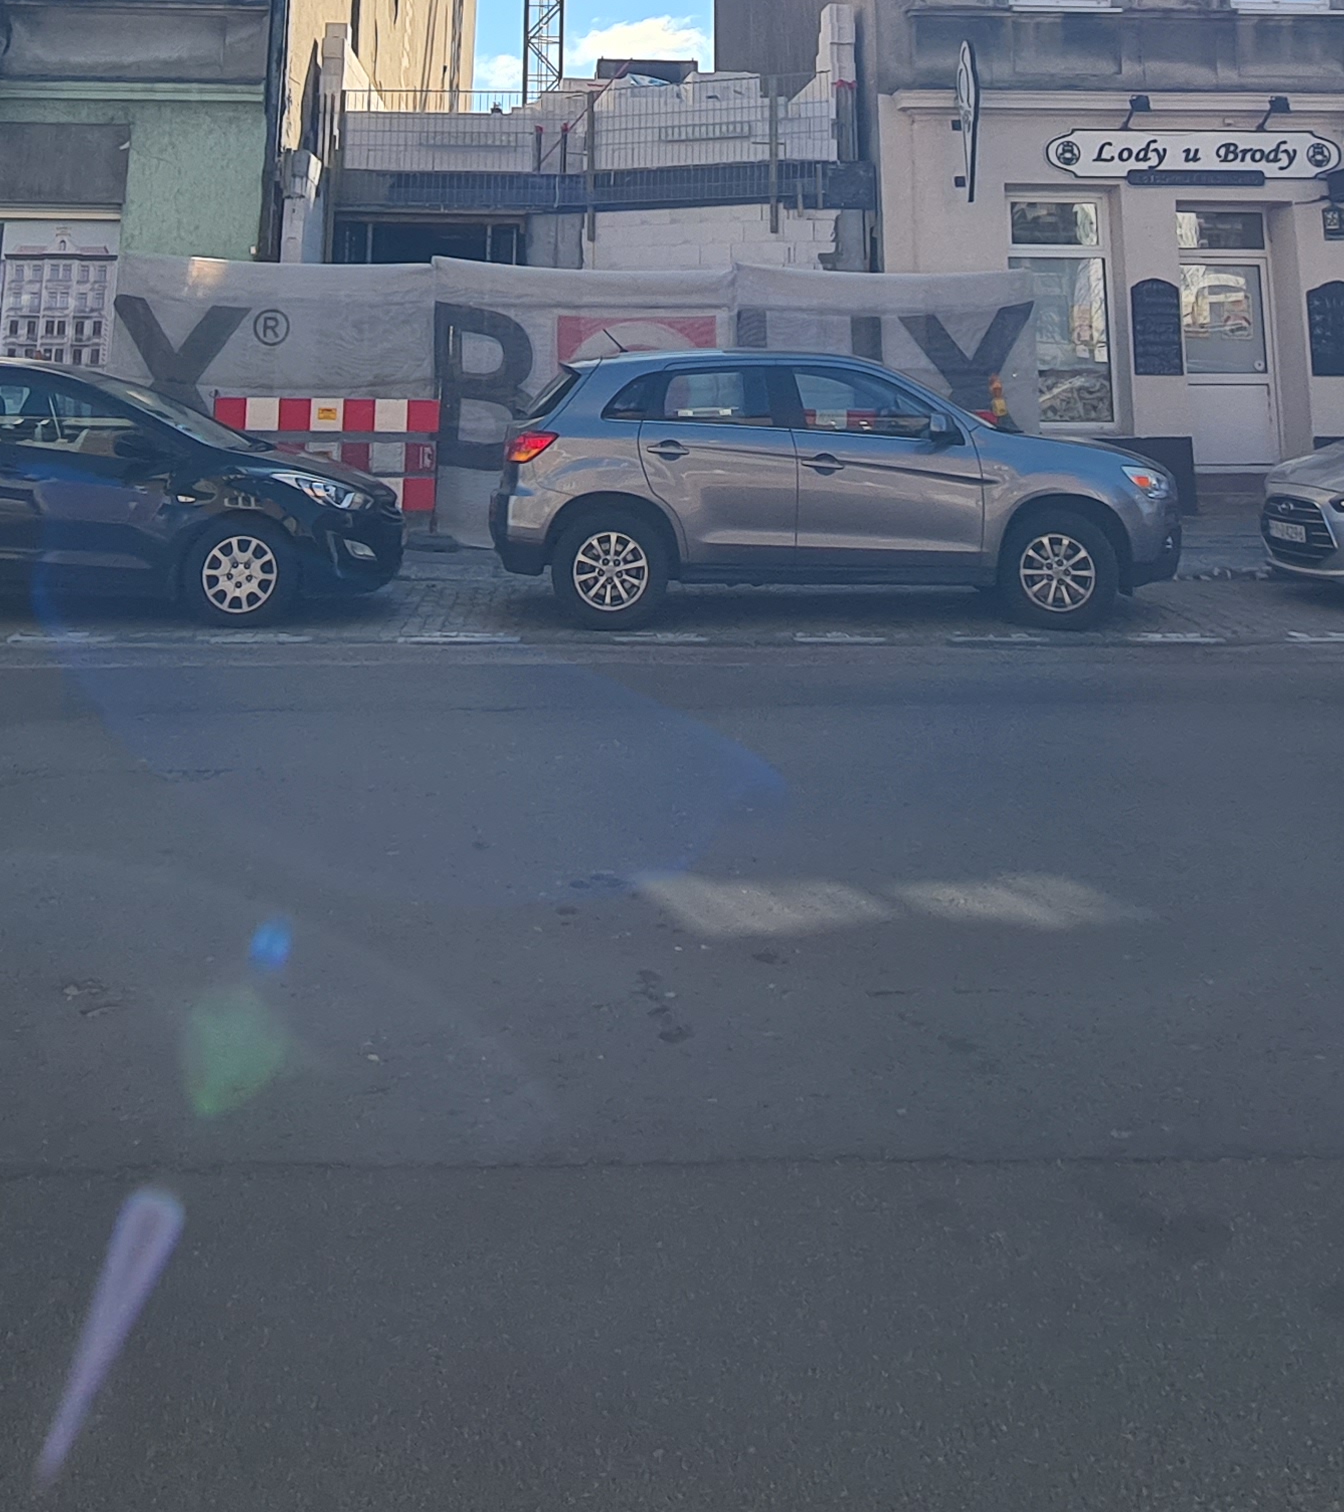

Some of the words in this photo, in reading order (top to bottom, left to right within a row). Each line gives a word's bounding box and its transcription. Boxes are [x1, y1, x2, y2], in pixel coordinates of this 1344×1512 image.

[1092, 139, 1167, 170] Lody
[1182, 147, 1202, 164] u
[1215, 140, 1298, 171] Brody
